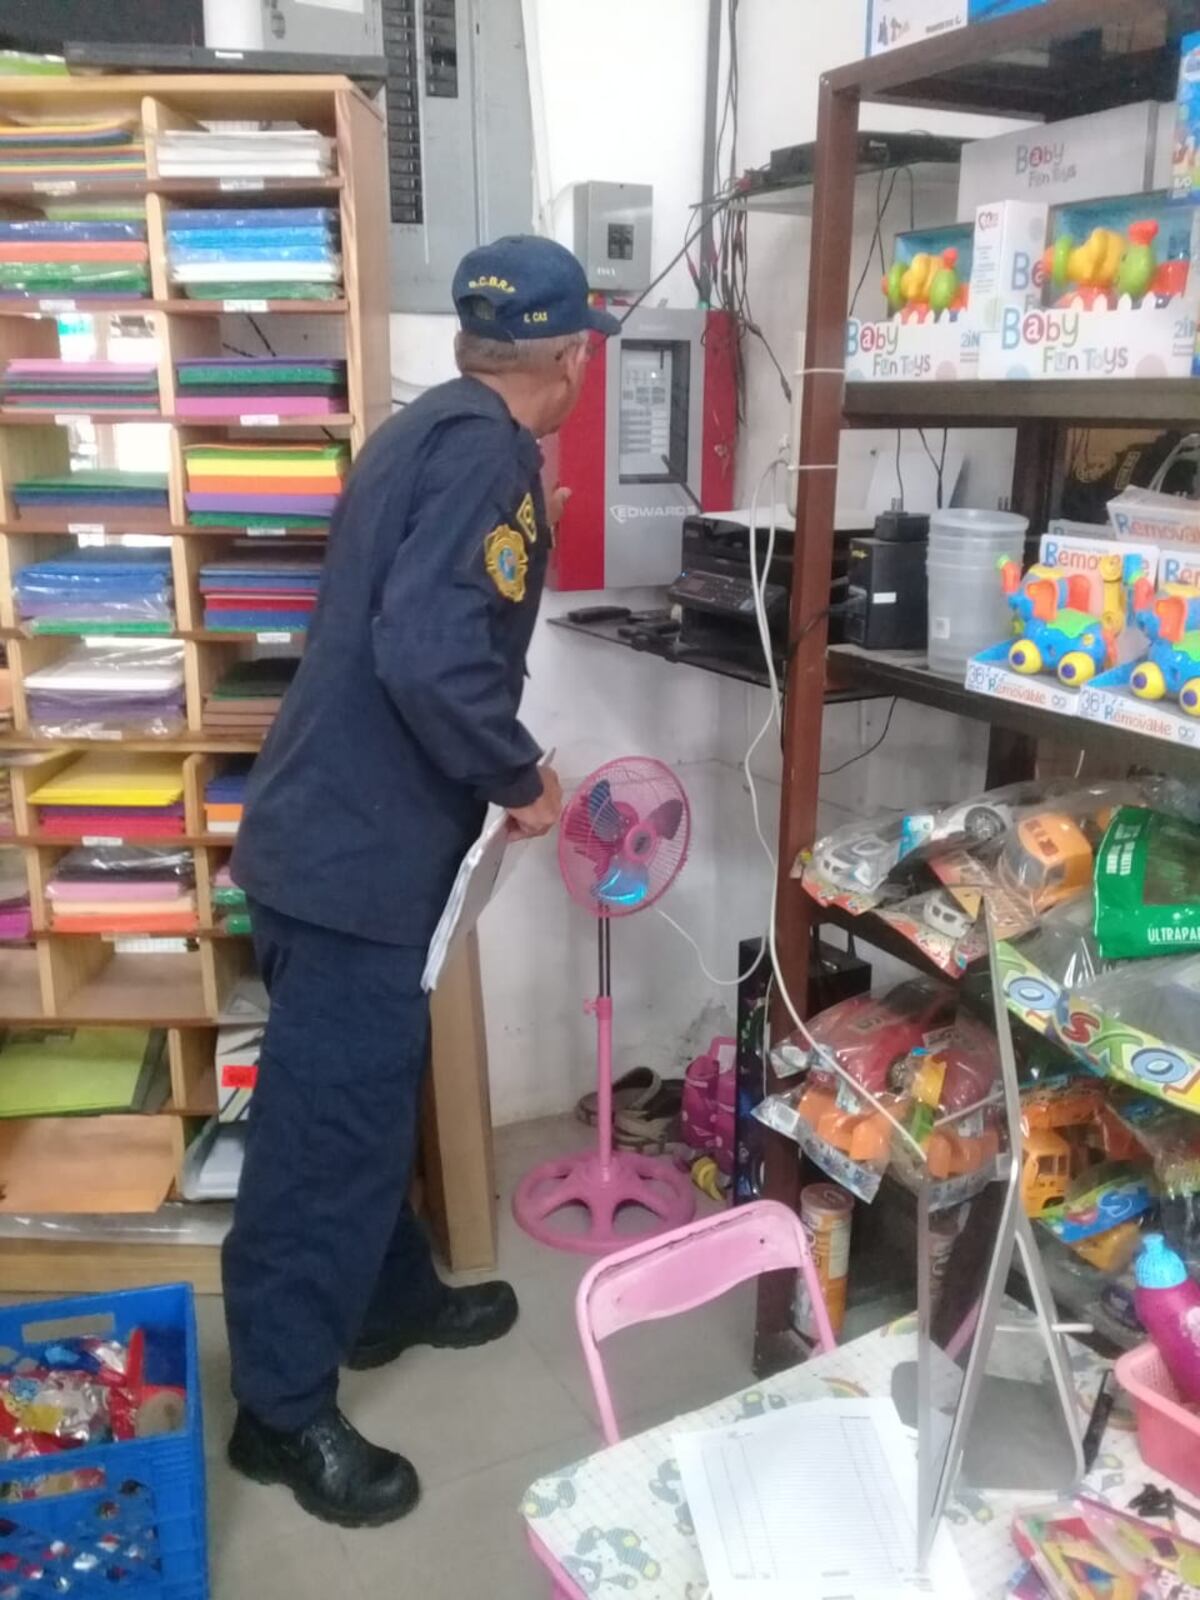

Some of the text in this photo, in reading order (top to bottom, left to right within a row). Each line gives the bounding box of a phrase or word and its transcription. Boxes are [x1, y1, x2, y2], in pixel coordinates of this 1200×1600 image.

[1015, 143, 1065, 175] Baby
[846, 320, 900, 357] Baby
[1001, 307, 1080, 350] Baby
[872, 353, 931, 377] Fun Toys
[1042, 347, 1129, 374] Fun Toys
[988, 678, 1046, 705] Removable
[1104, 704, 1172, 736] Removable
